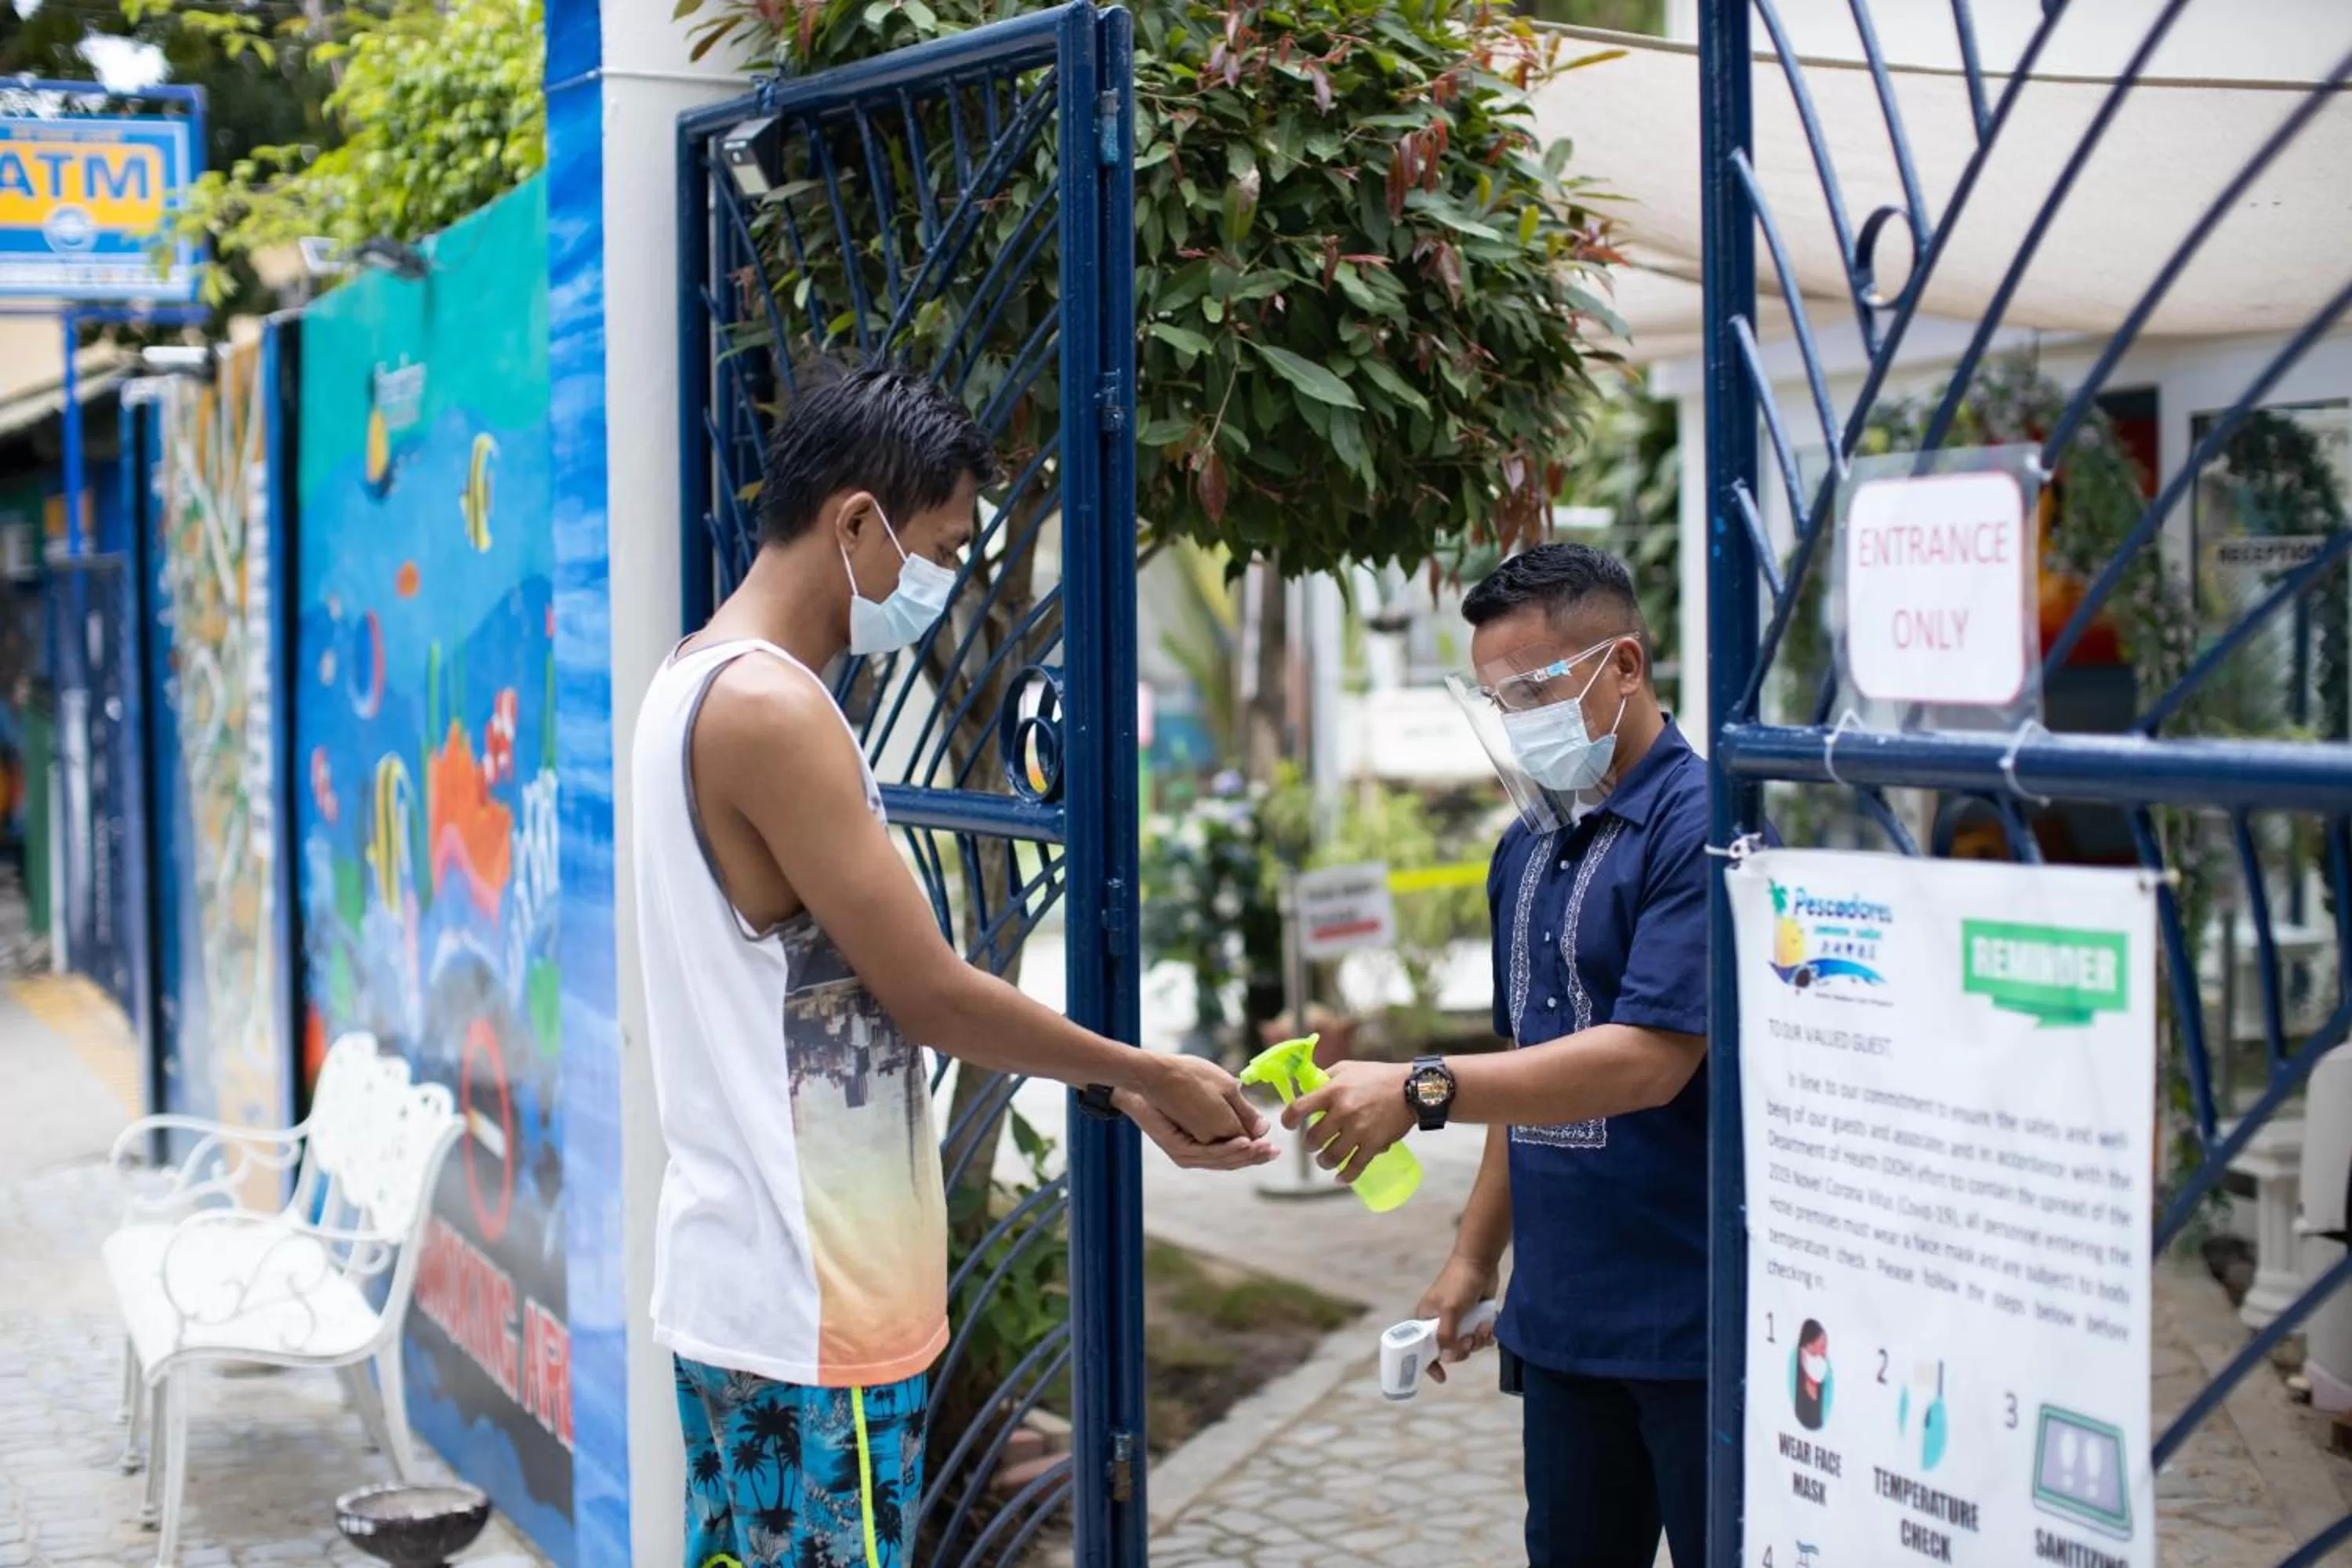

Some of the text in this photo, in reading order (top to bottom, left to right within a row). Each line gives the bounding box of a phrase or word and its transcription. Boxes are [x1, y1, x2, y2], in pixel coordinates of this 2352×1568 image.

[0, 151, 150, 201] ATM
[1857, 521, 2009, 568] ENTRANCE
[1891, 608, 1969, 652] ONLY
[1972, 935, 2117, 993] REMINDER
[1765, 1311, 1777, 1344] 1
[1876, 1348, 1889, 1385] 2
[2005, 1392, 2020, 1429] 3
[1778, 1431, 1843, 1479] WEAR FACE
[1791, 1472, 1828, 1507] MASK
[1872, 1466, 1980, 1533] TEMPERATURE
[1761, 1544, 1773, 1568] 4
[1900, 1517, 1953, 1563] CHECK
